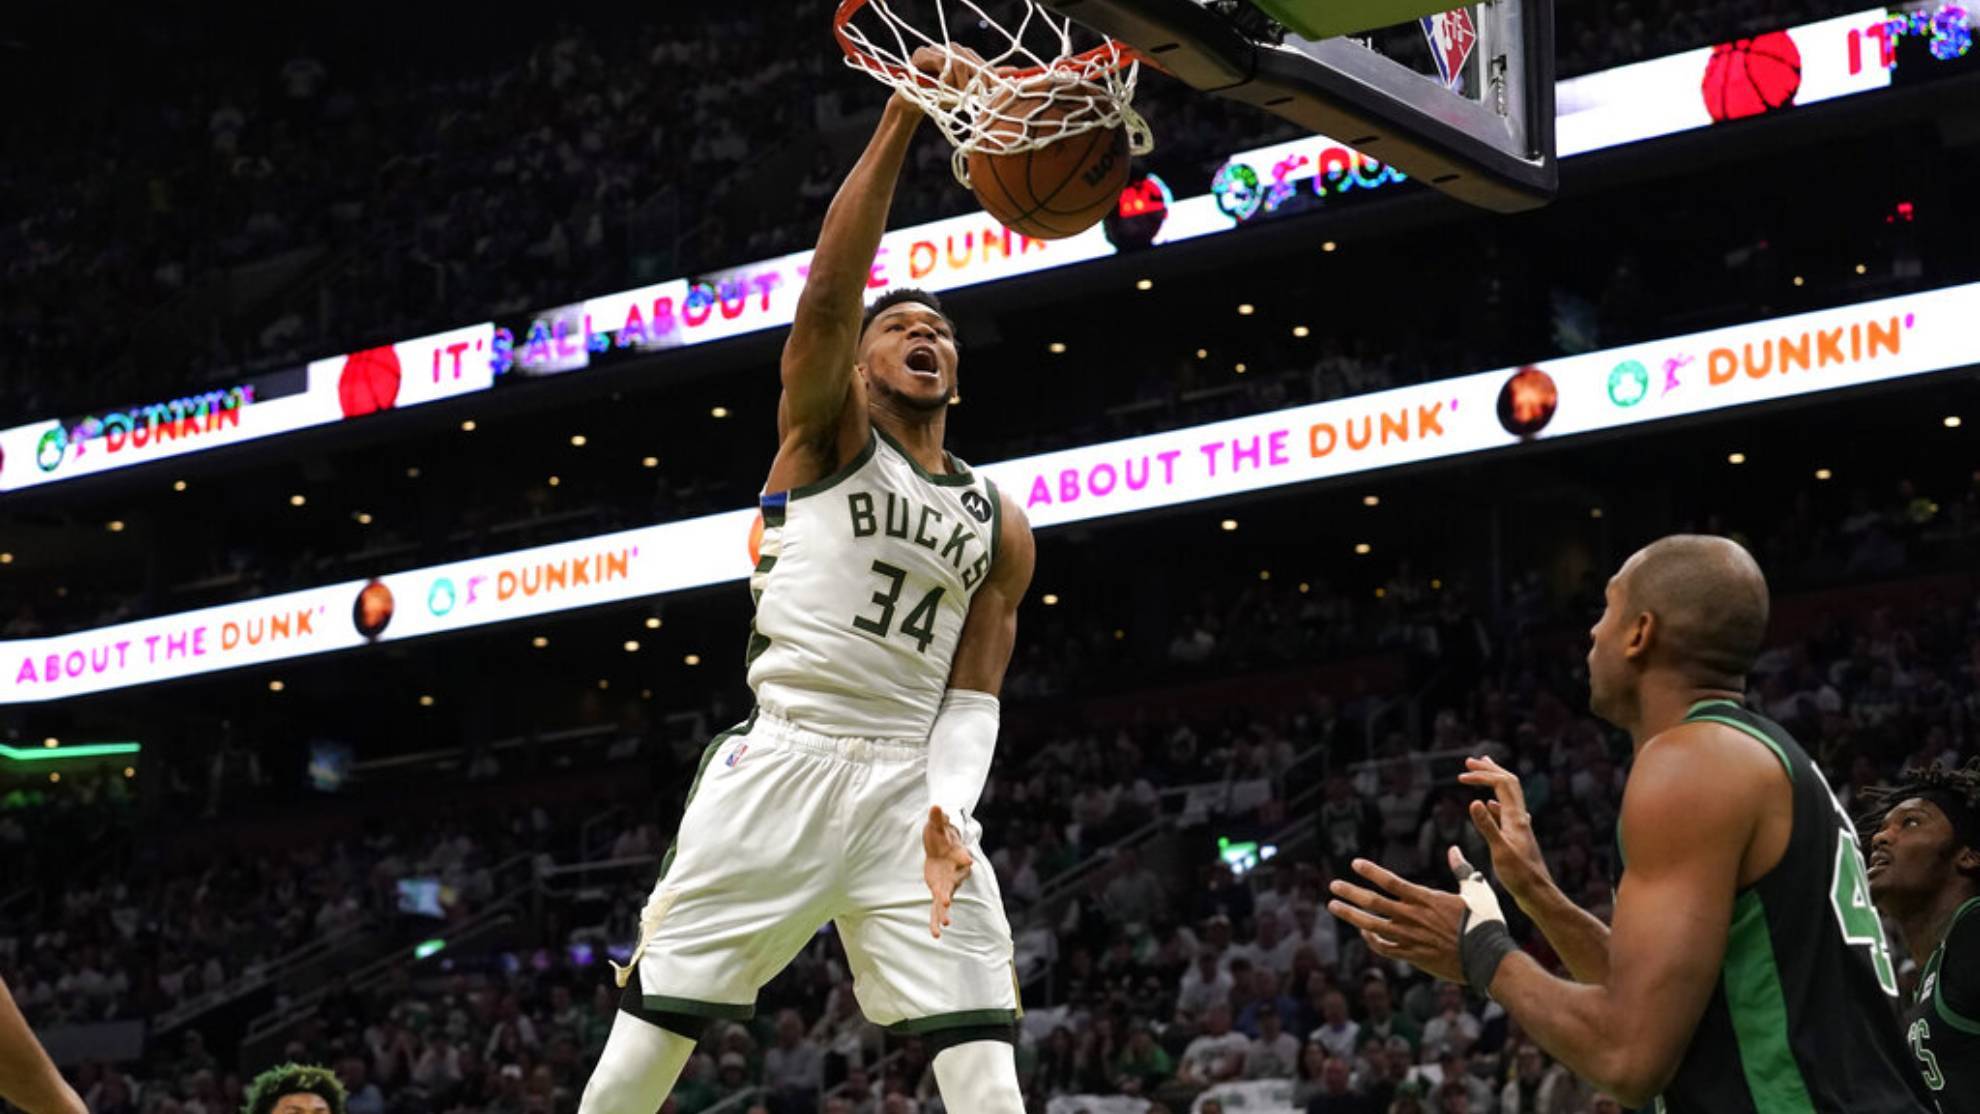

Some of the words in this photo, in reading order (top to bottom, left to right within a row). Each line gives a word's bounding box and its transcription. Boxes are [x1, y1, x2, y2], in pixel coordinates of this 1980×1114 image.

[1707, 312, 1915, 386] DUNKIN'
[1026, 449, 1181, 509] ABOUT
[1199, 429, 1291, 477] THE
[1308, 398, 1459, 458] DUNK'
[497, 545, 639, 602] DUNKIN'
[847, 490, 989, 592] BUCKS
[15, 640, 132, 684] ABOUT
[144, 626, 207, 664] THE
[221, 605, 325, 651] DUNK'
[852, 559, 946, 653] 34
